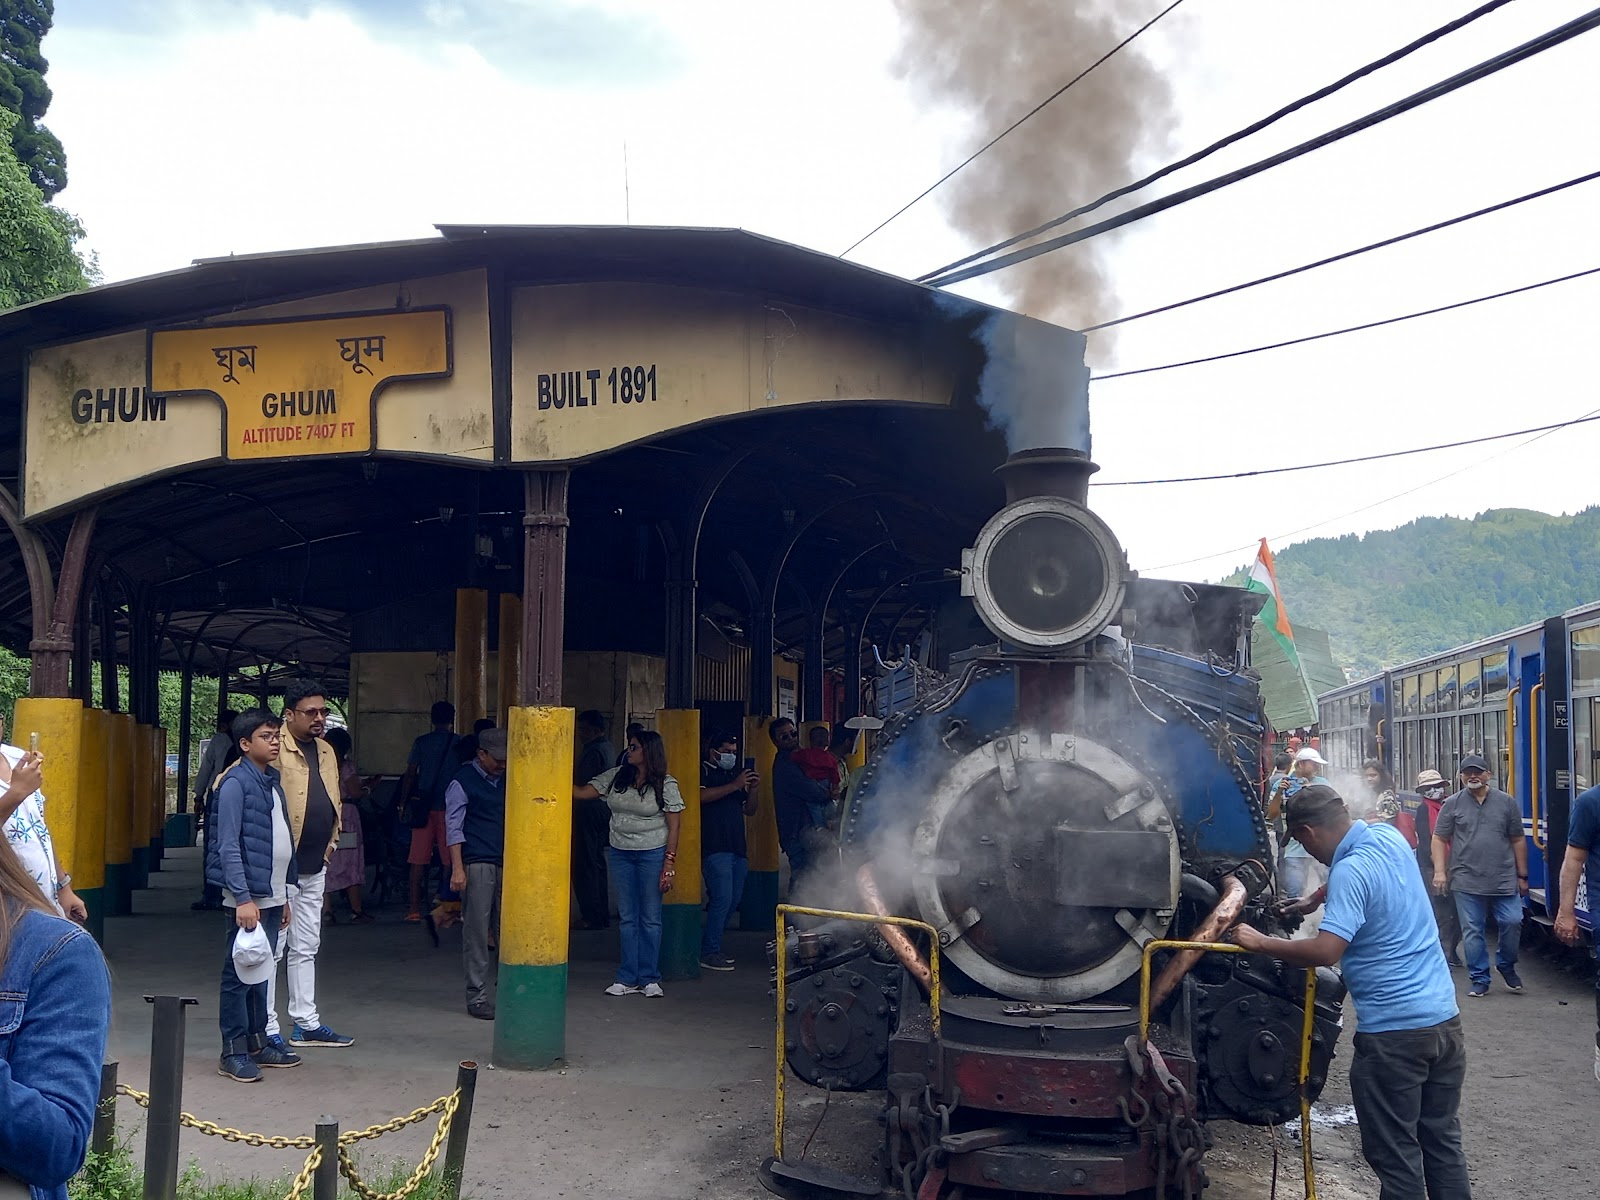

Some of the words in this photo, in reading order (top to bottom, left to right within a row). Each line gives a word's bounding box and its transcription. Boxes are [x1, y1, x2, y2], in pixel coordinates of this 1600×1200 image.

[212, 345, 257, 384] ঘুম
[336, 335, 386, 376] घूम
[71, 387, 167, 424] GHUM
[261, 389, 337, 418] GHUM
[538, 369, 600, 410] BUILT
[608, 364, 656, 403] 1891
[243, 426, 302, 444] ALTITUDE
[306, 423, 336, 440] 7407
[341, 422, 355, 438] FT
